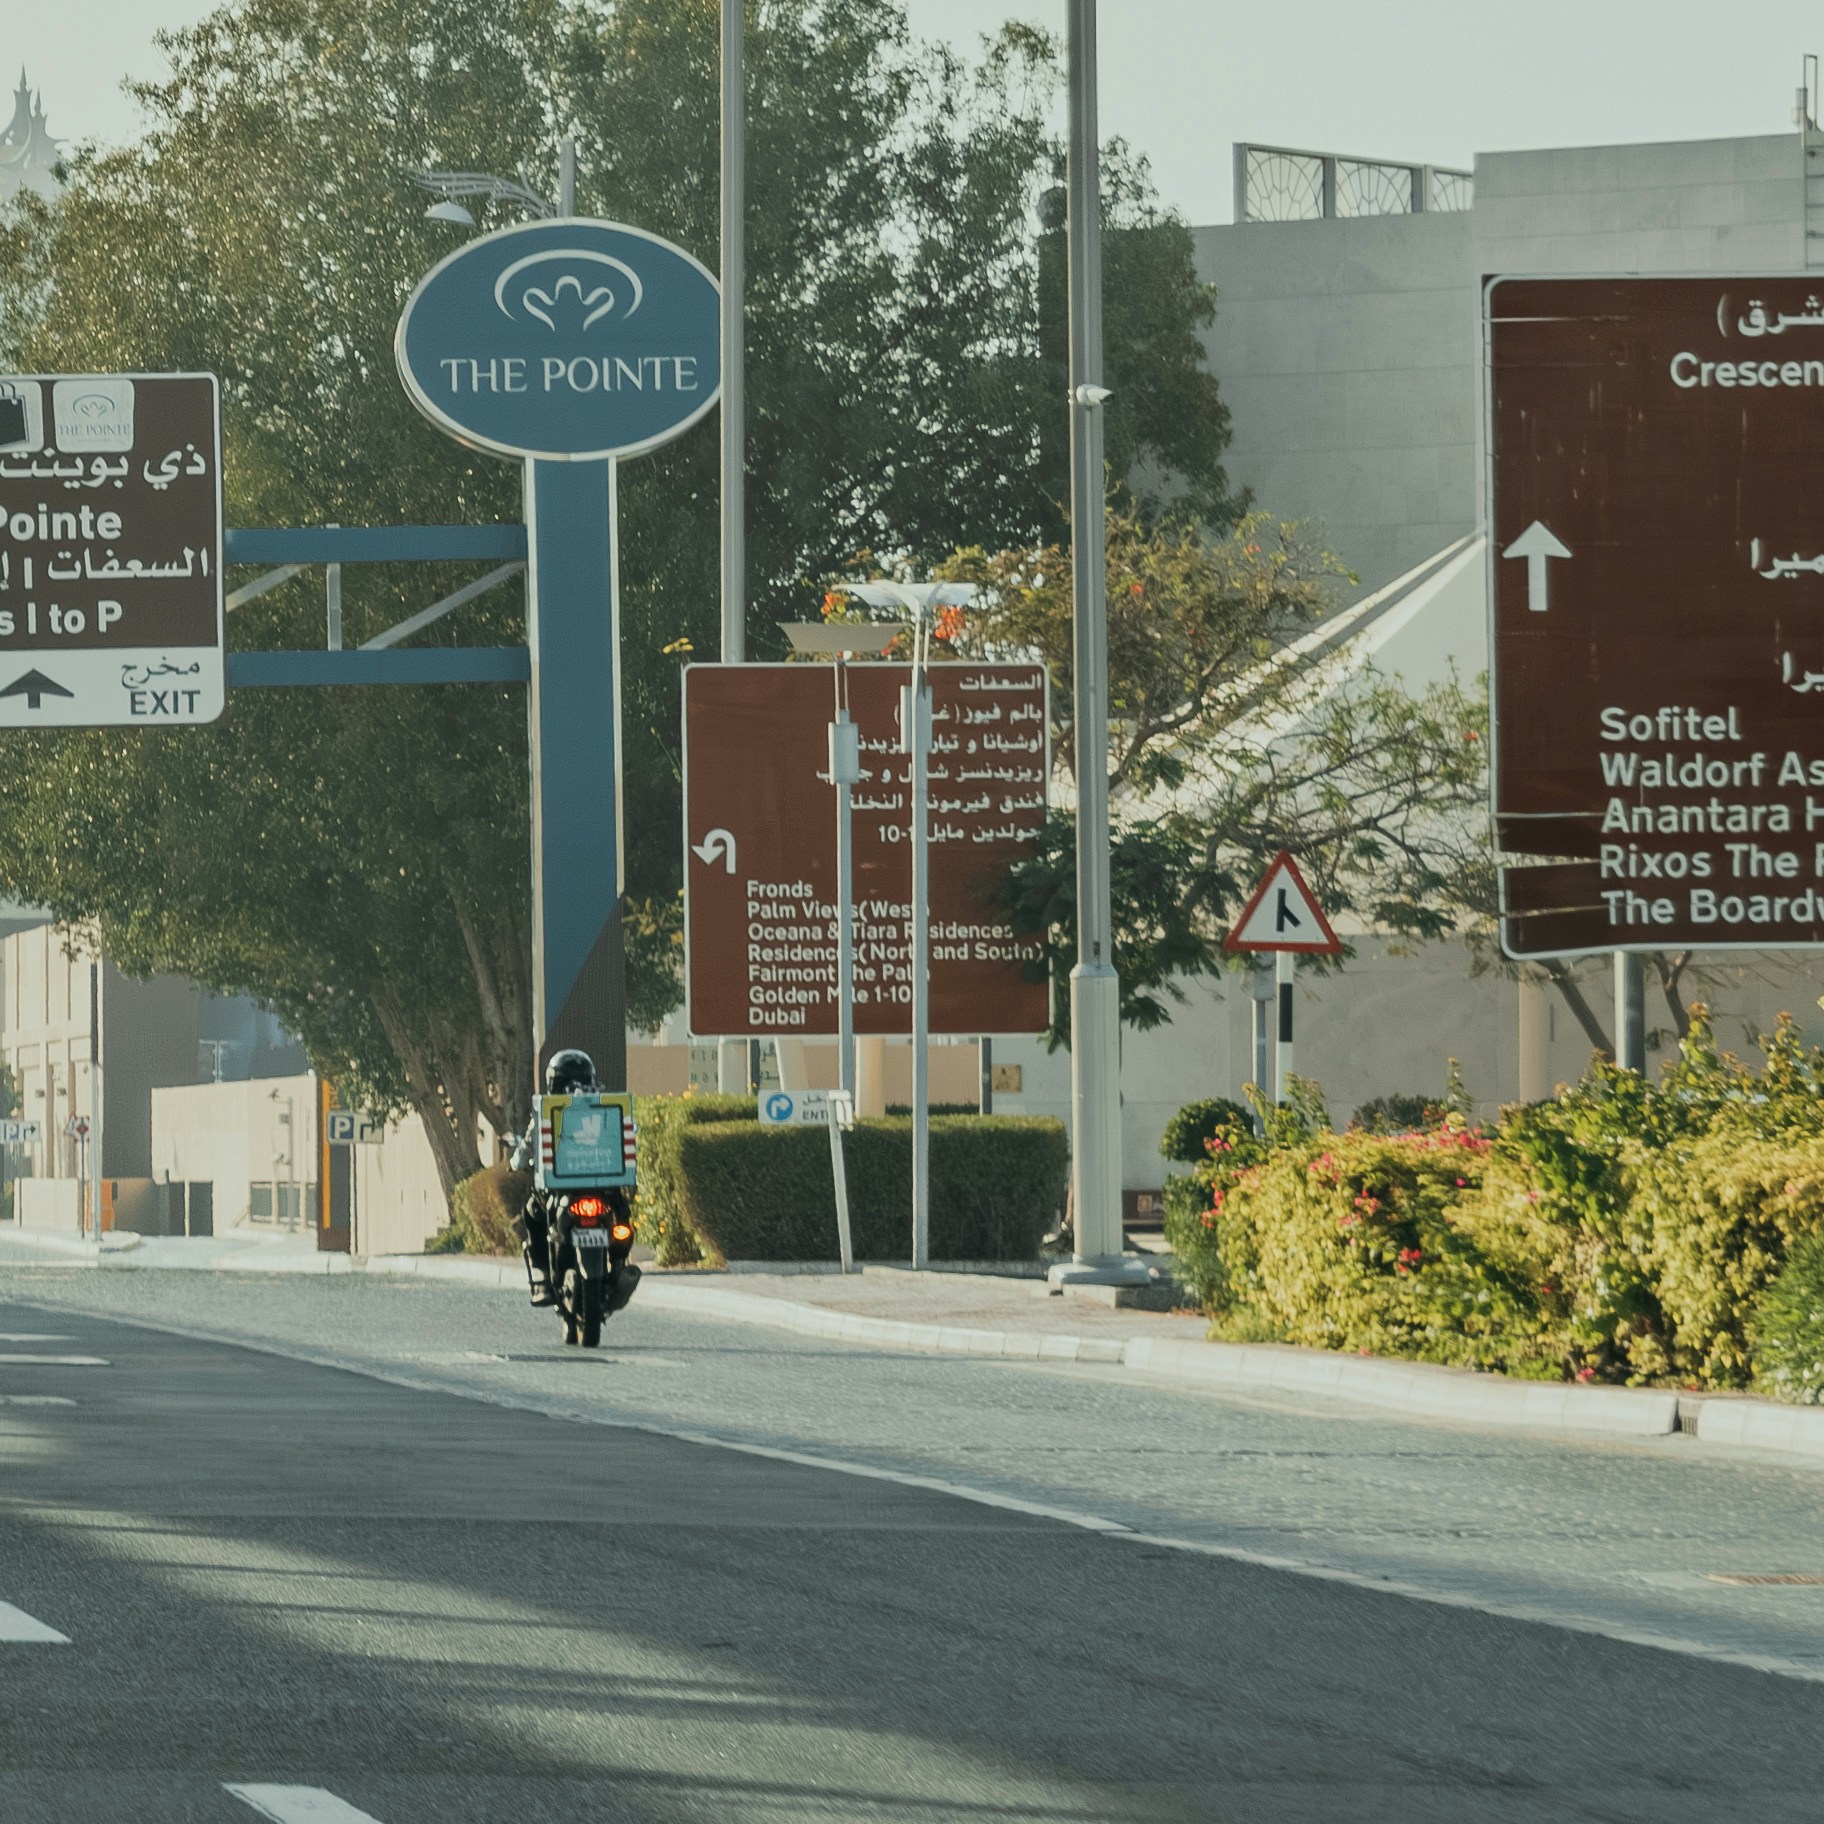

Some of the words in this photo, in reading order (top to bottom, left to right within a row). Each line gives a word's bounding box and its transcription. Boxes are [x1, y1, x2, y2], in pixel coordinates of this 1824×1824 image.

[440, 357, 528, 393] THE
[541, 356, 700, 393] POINTE
[0, 448, 129, 489] بوينت
[143, 443, 205, 490] ذي
[47, 547, 209, 580] السعفات
[49, 603, 86, 634] to
[97, 600, 123, 633] P
[120, 656, 201, 689] مخرج
[129, 689, 202, 716] EXIT
[1600, 706, 1741, 741] Sofitel
[1600, 752, 1766, 788] Waldorf
[1601, 796, 1790, 834] Anantara
[1600, 843, 1712, 879] Rixos
[1724, 842, 1799, 878] The
[747, 880, 813, 898] Fronds
[747, 901, 796, 919] Palm
[1600, 889, 1675, 925] The
[748, 922, 822, 940] Oceana
[851, 921, 897, 940] Tiara
[904, 921, 1013, 939] Rsidences
[933, 943, 968, 960] and
[749, 964, 836, 982] Fairmont
[883, 963, 930, 982] Pal
[749, 985, 820, 1004] Golden
[827, 985, 868, 1004] Mle
[875, 985, 911, 1004] 1-10
[749, 1006, 805, 1025] Dubai
